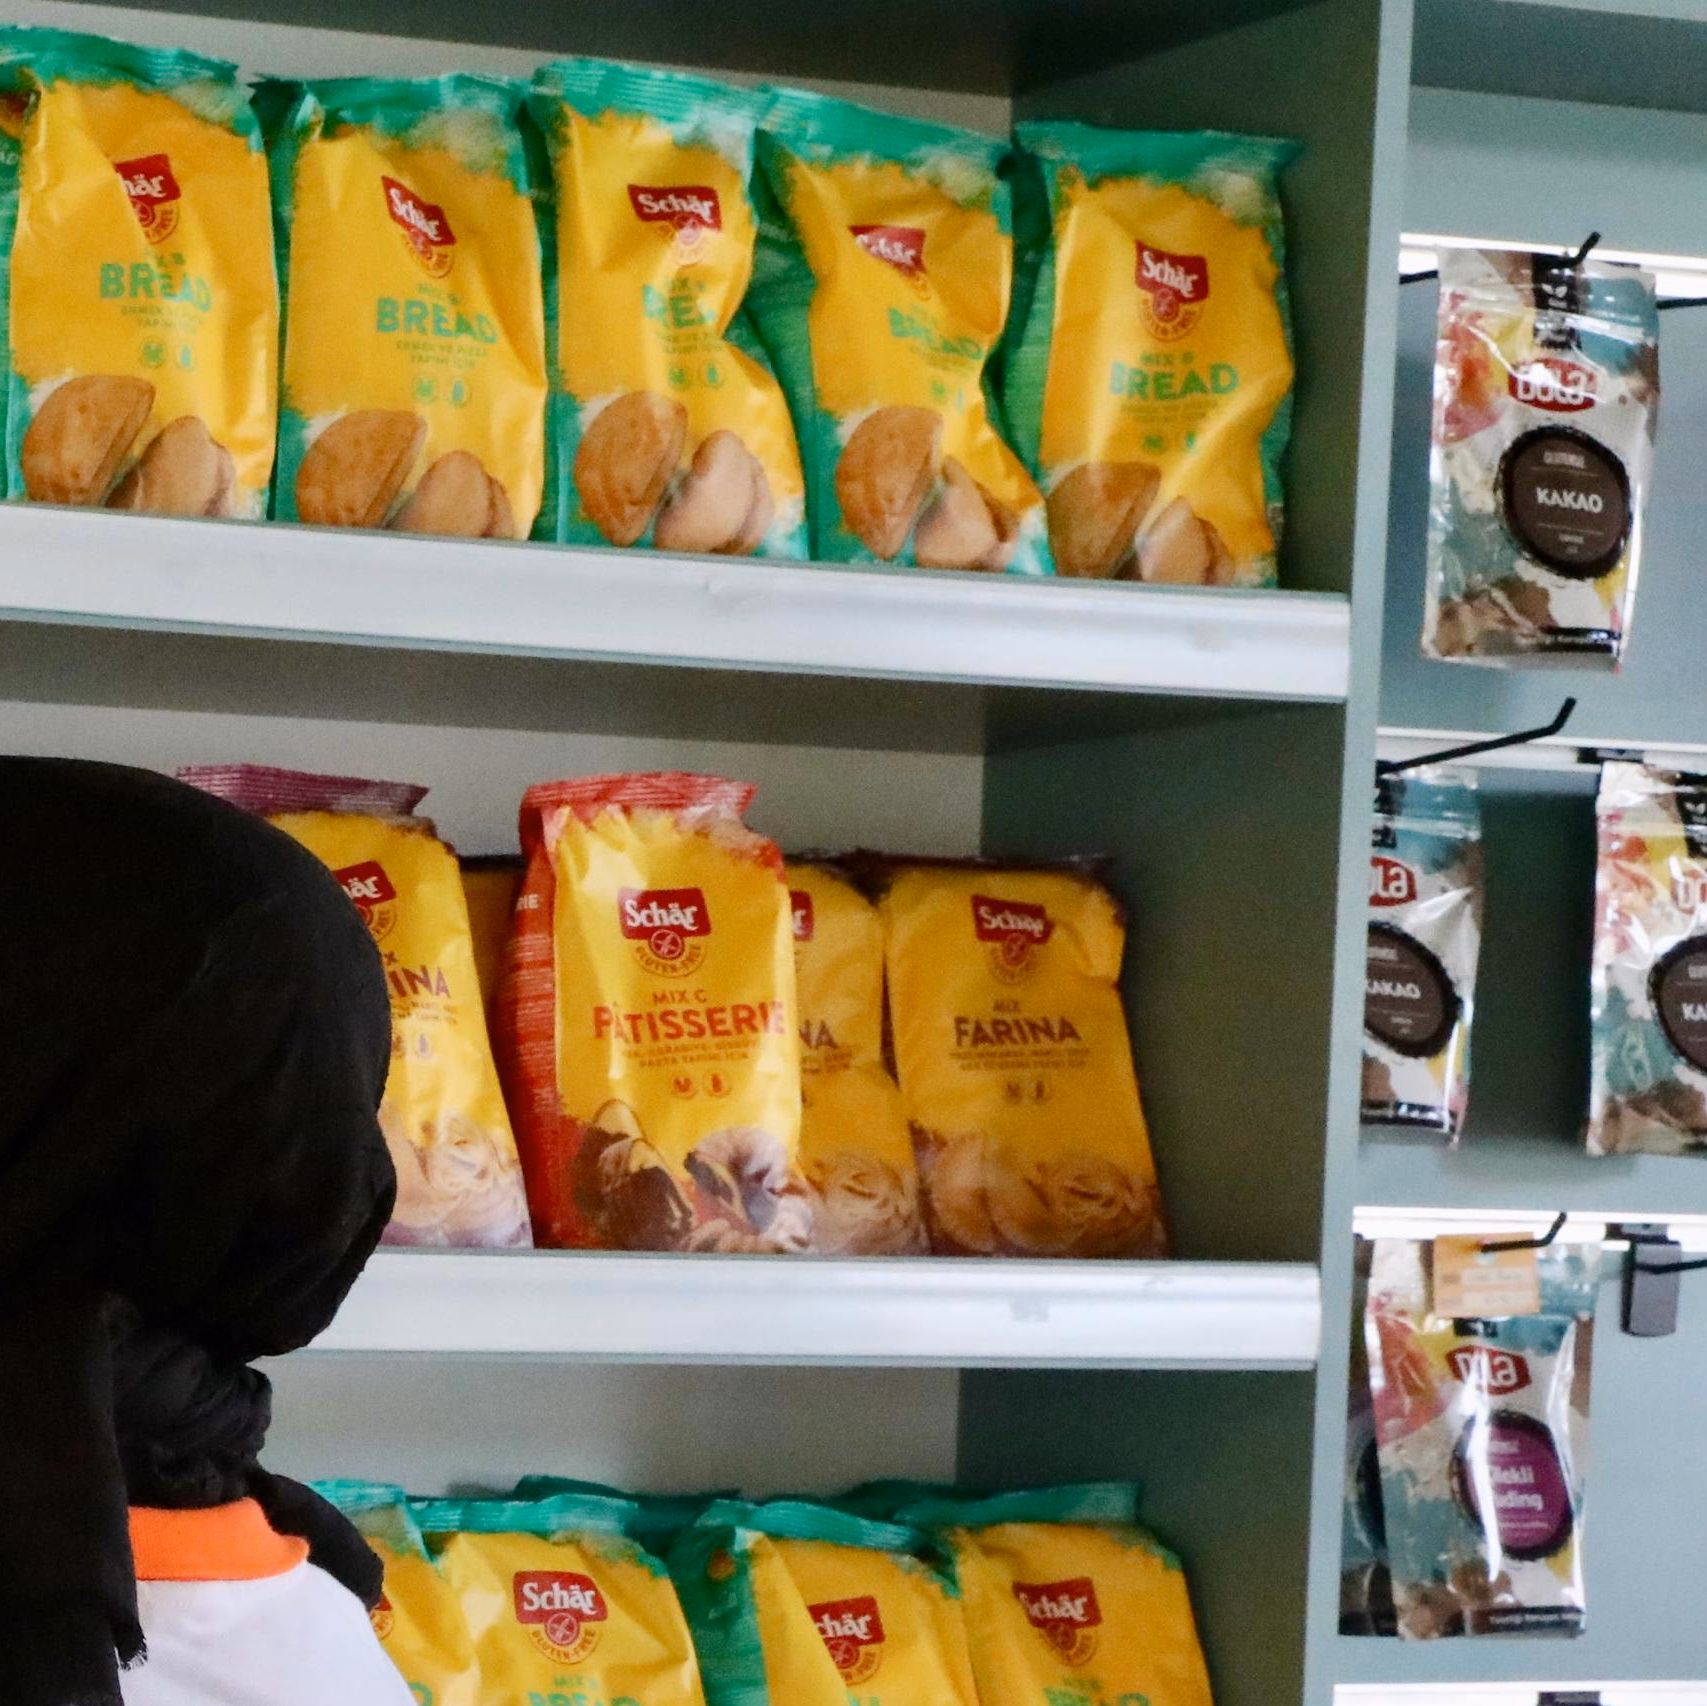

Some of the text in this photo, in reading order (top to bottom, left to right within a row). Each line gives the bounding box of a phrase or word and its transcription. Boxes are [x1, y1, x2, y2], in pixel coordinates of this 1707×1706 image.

[100, 262, 212, 314] BREAD
[376, 296, 500, 345] BREAD
[1109, 361, 1241, 403] BREAD
[1537, 487, 1603, 513] KAKAO
[623, 899, 699, 933] Schär
[653, 990, 687, 1004] MIX
[953, 1015, 1084, 1047] FARINA
[522, 1582, 597, 1613] Schär
